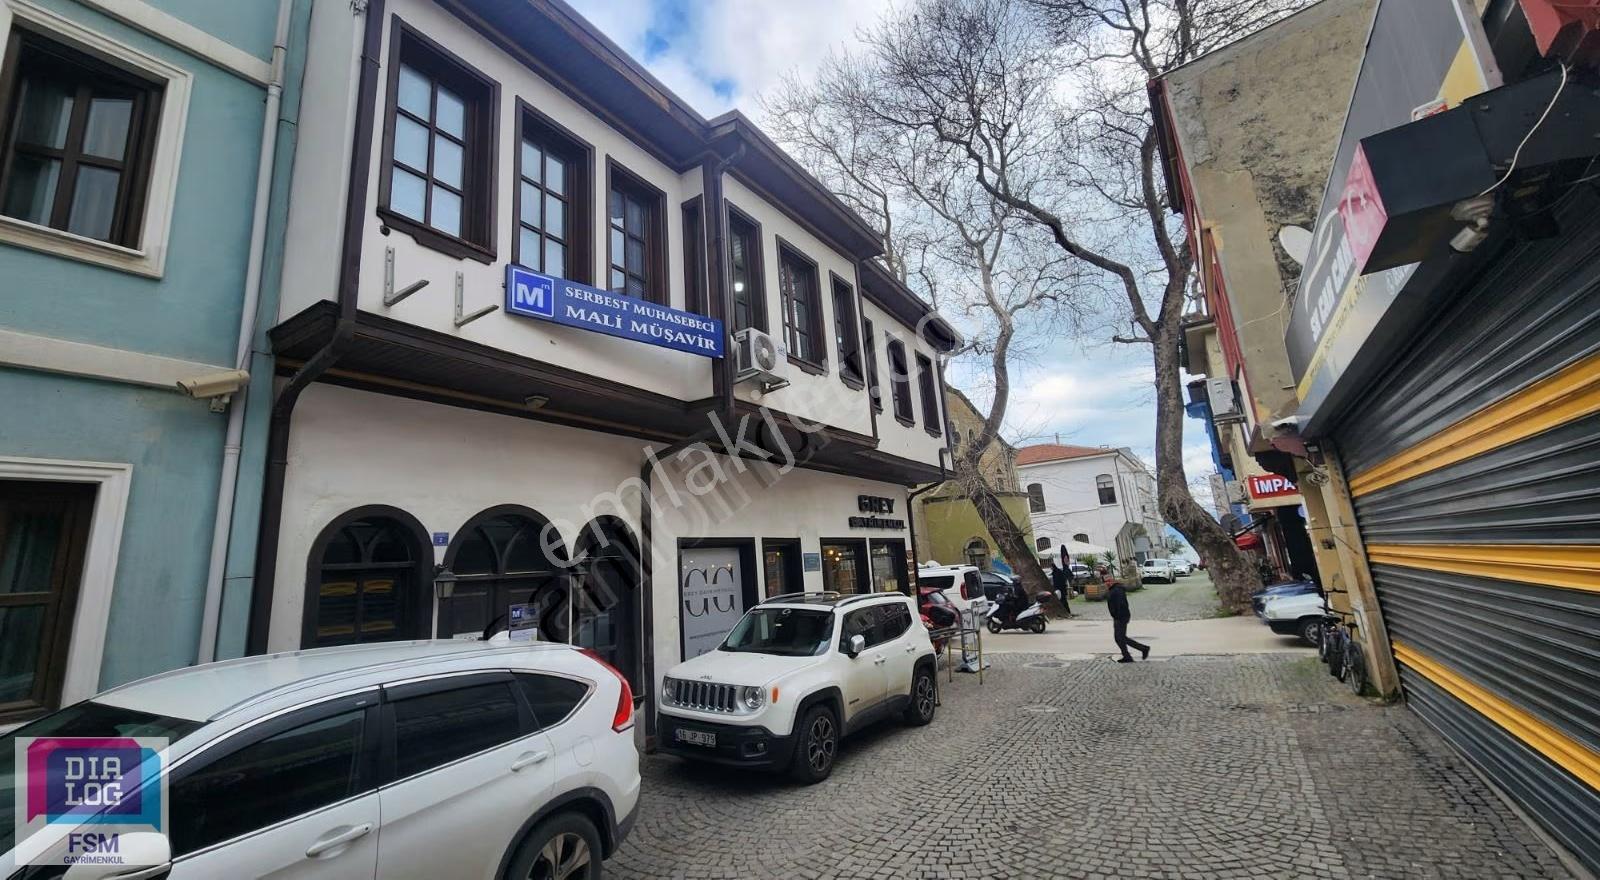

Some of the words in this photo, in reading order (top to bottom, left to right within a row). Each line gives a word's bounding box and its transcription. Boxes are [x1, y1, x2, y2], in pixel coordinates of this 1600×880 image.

[565, 286, 630, 311] SERBEST
[633, 303, 715, 333] MUHASEBECİ
[566, 305, 622, 329] MALİ
[630, 320, 716, 351] MÜŞAVİR
